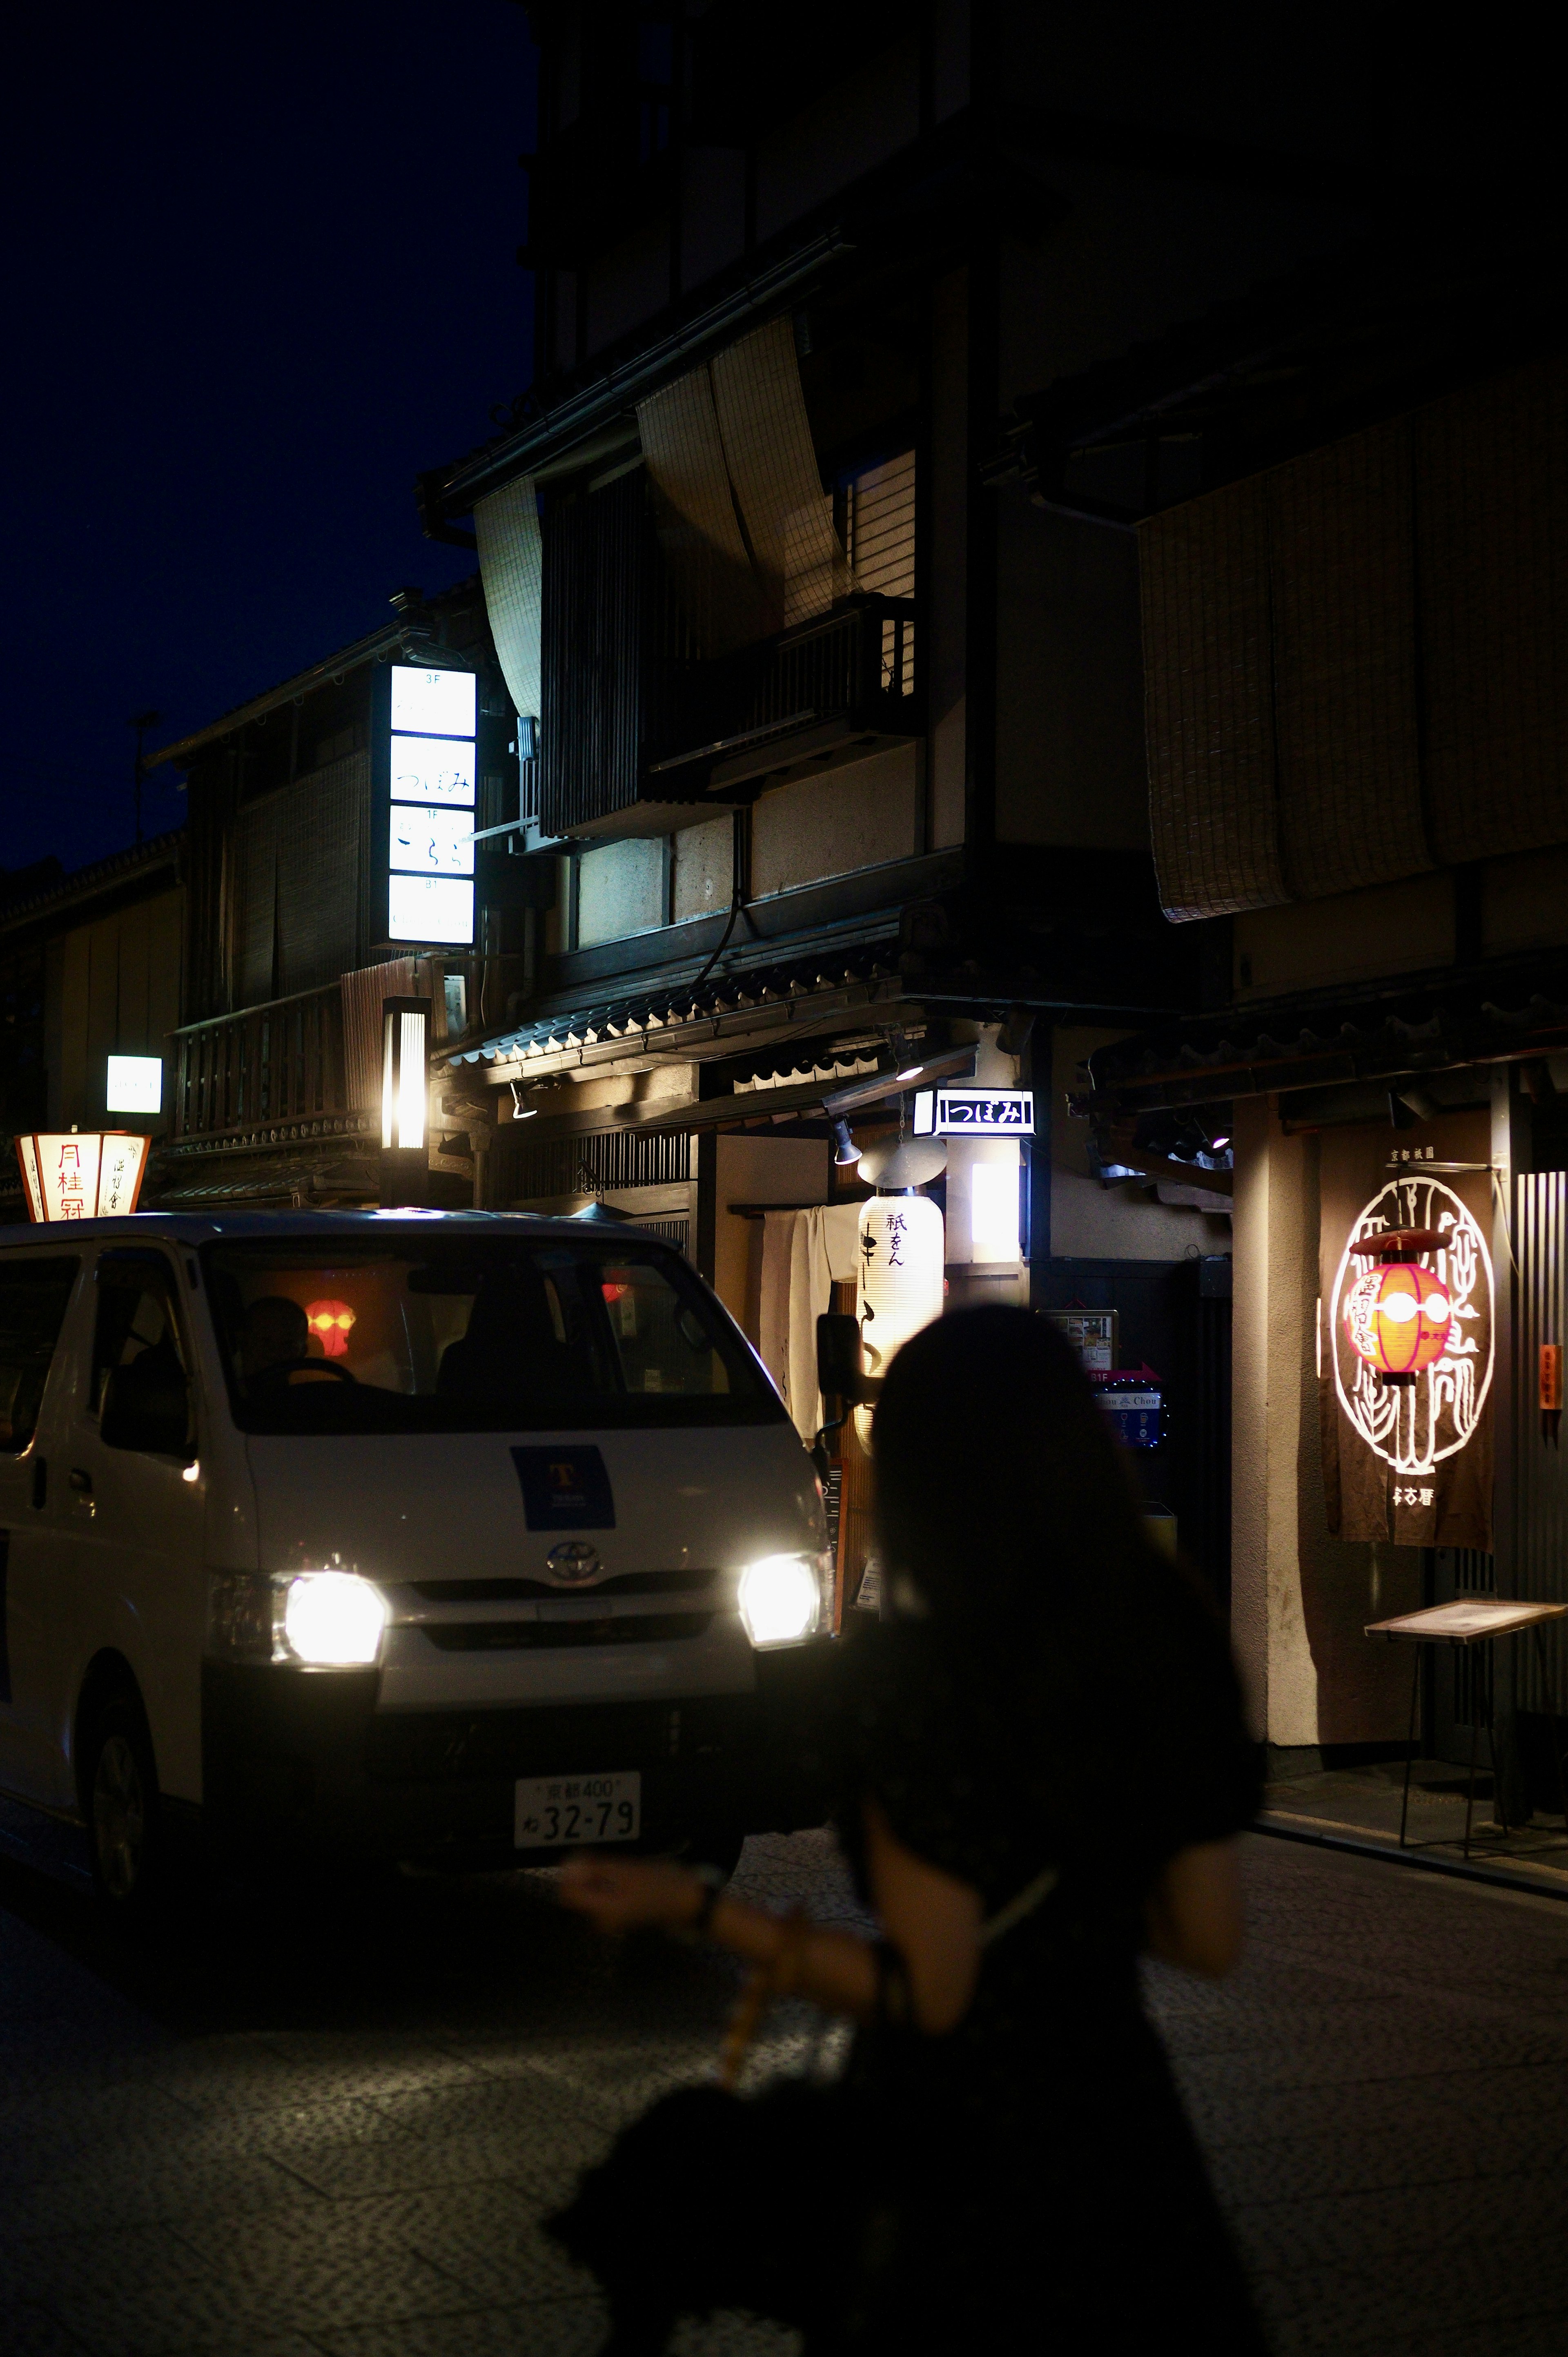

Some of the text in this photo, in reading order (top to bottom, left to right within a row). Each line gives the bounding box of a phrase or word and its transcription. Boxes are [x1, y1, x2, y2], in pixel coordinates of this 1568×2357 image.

[426, 674, 441, 683] 3F
[397, 771, 469, 792] つぼみ
[427, 810, 437, 819] 1F
[426, 880, 436, 888] B1
[950, 1101, 1020, 1123] つぼみ
[57, 1144, 85, 1220] 月桂冠
[886, 1213, 907, 1266] 祇をん
[1091, 1373, 1108, 1382] B1F
[1134, 1396, 1156, 1405] Chou
[544, 1801, 633, 1840] 32-79
